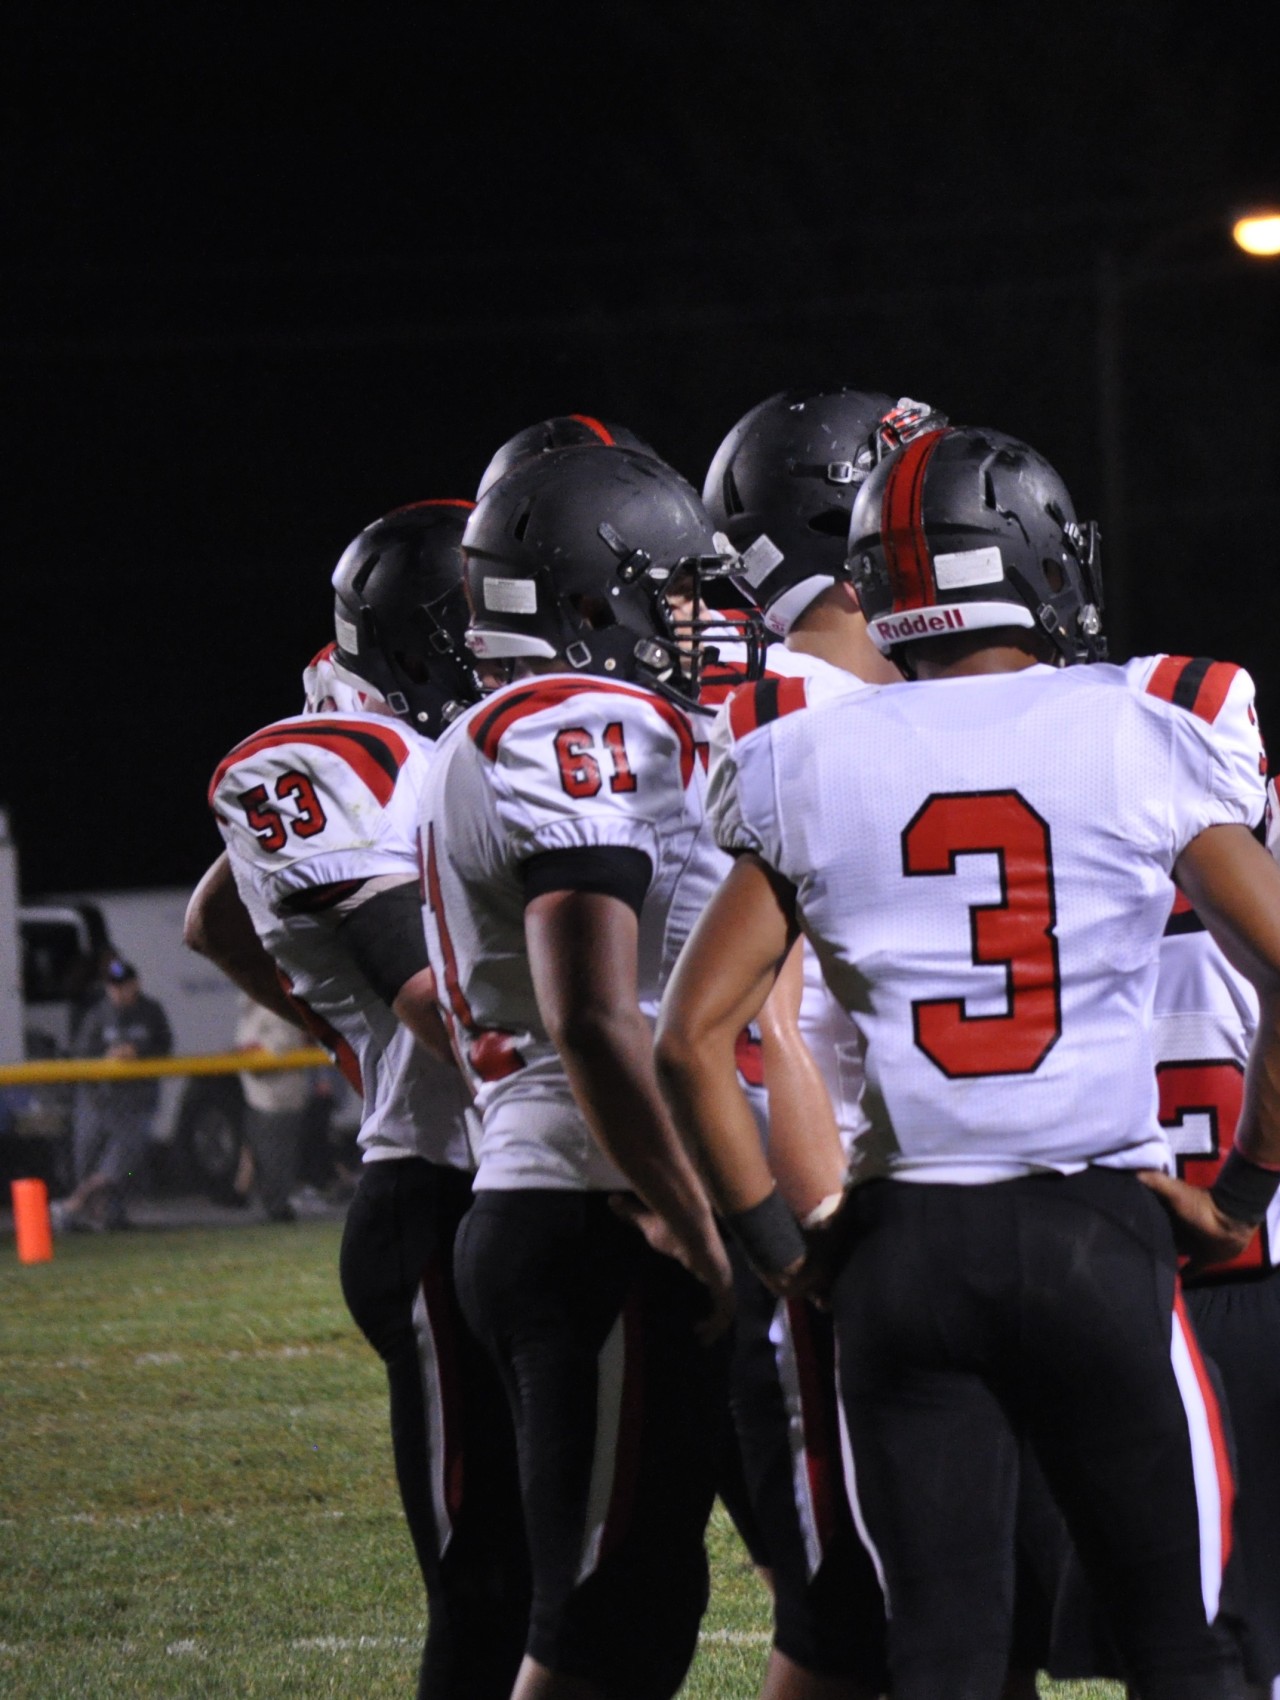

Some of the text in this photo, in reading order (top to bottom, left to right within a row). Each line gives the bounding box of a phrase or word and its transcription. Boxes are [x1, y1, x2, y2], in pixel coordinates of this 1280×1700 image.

[876, 608, 965, 641] Riddell
[553, 721, 639, 799] 61
[237, 769, 328, 853] 53
[901, 788, 1062, 1080] 3
